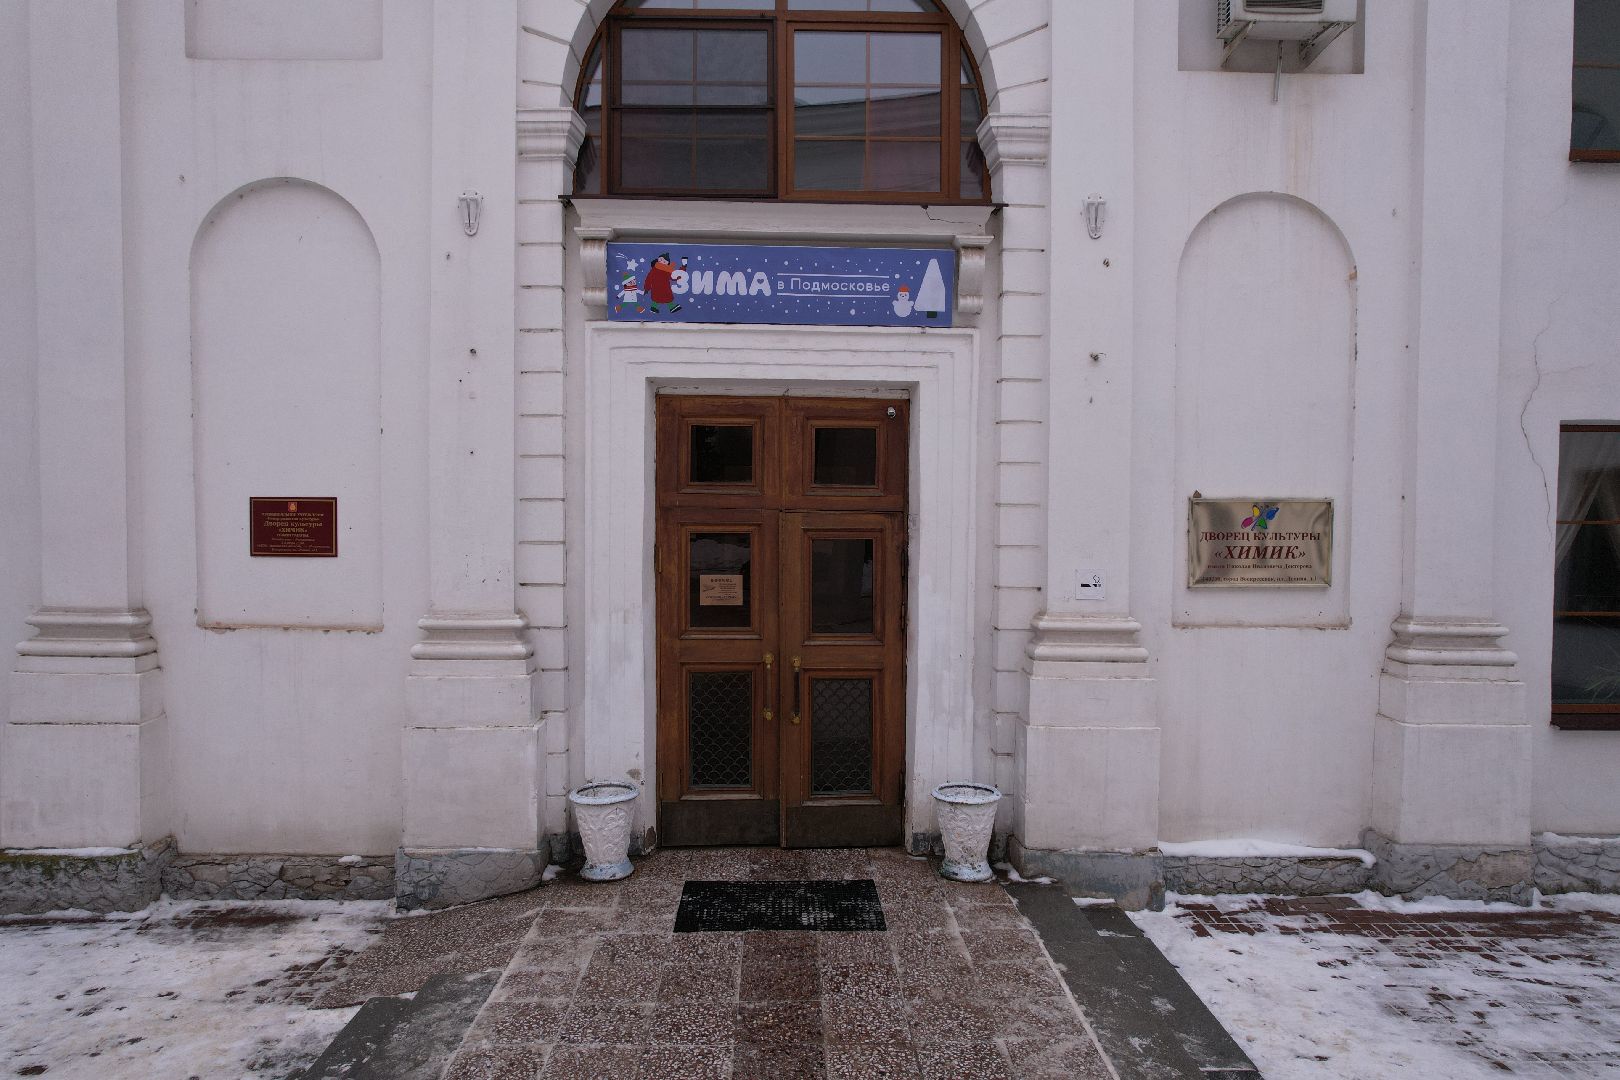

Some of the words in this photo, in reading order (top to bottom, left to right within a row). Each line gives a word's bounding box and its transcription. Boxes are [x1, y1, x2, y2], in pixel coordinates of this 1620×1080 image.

[670, 270, 772, 297] ЗИМА
[777, 281, 785, 291] в
[790, 277, 890, 293] Подмосковье
[1200, 531, 1250, 542] ДВОРЕЦ
[1253, 531, 1320, 541] КУЛЬТУРЫ
[1215, 545, 1306, 560] «ХИМИК»
